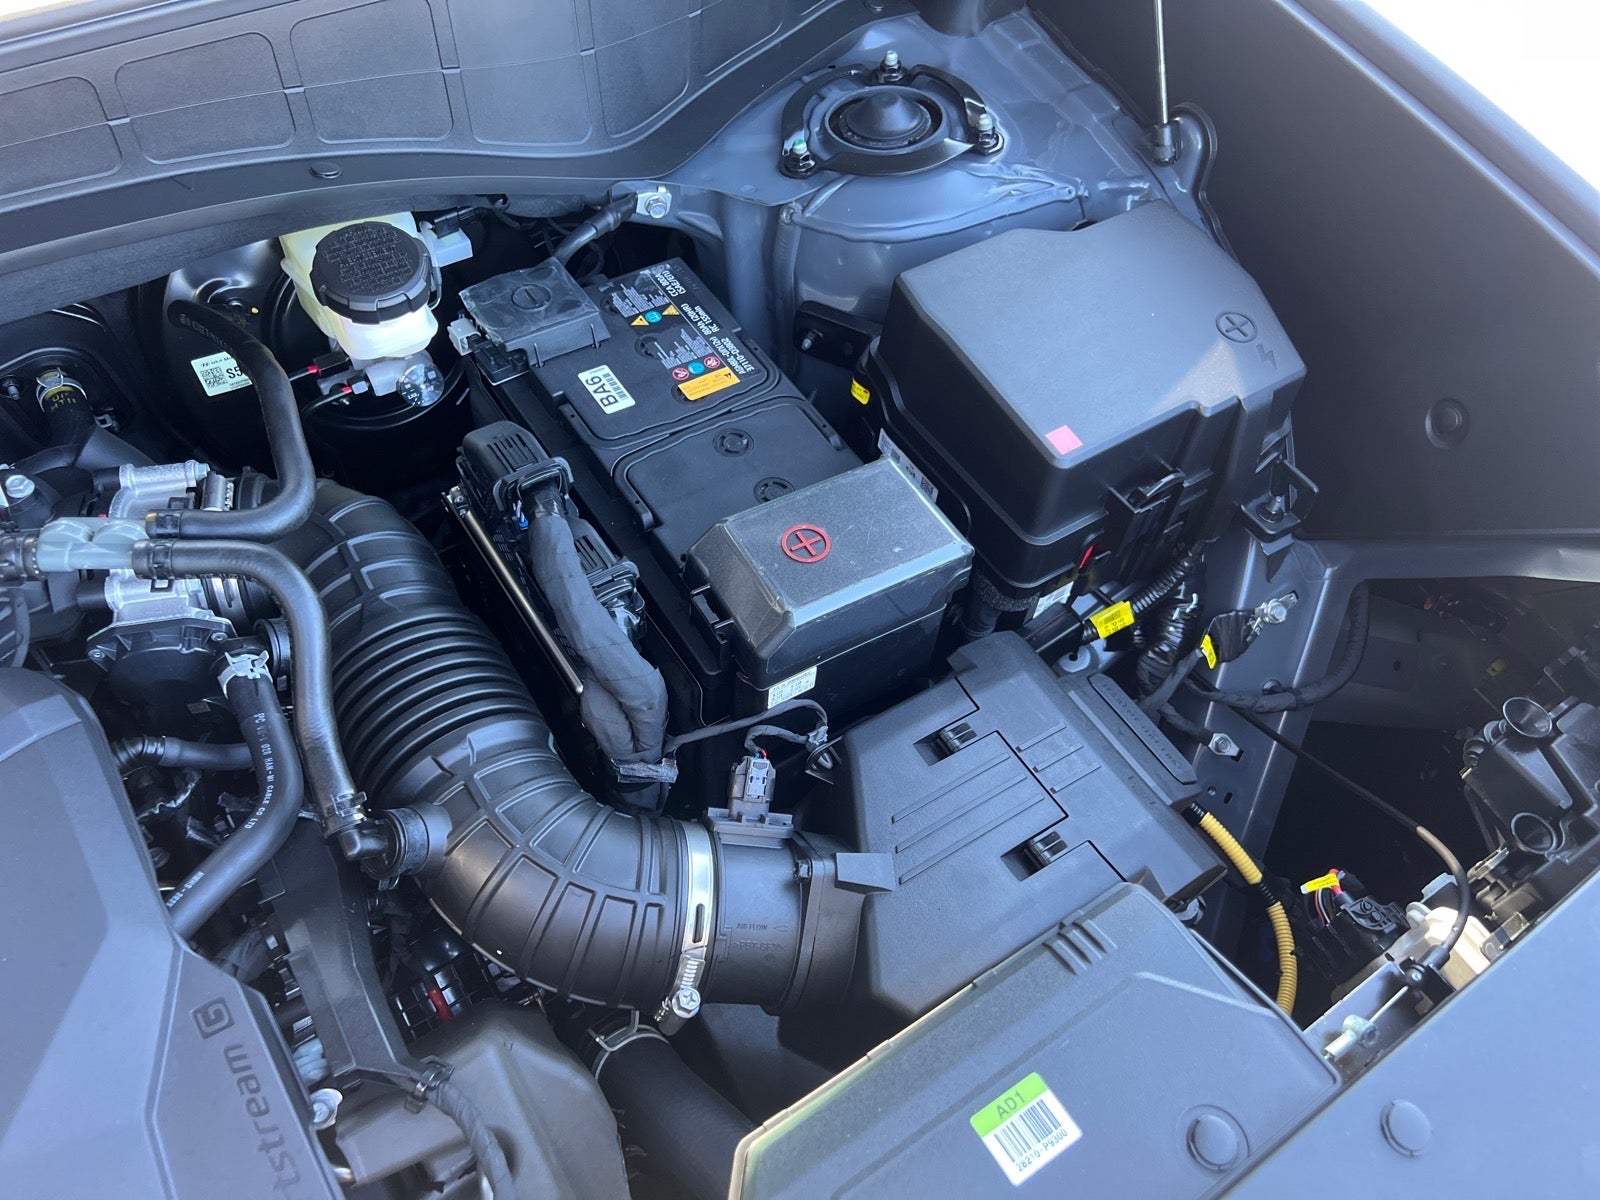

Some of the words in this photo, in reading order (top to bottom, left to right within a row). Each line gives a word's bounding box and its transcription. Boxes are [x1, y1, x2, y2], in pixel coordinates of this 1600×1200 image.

[585, 375, 618, 407] BA6
[262, 785, 273, 804] CABLE
[996, 1090, 1026, 1119] AD1
[224, 1043, 302, 1200] tstream
[1016, 1127, 1069, 1172] 28210-P9300
